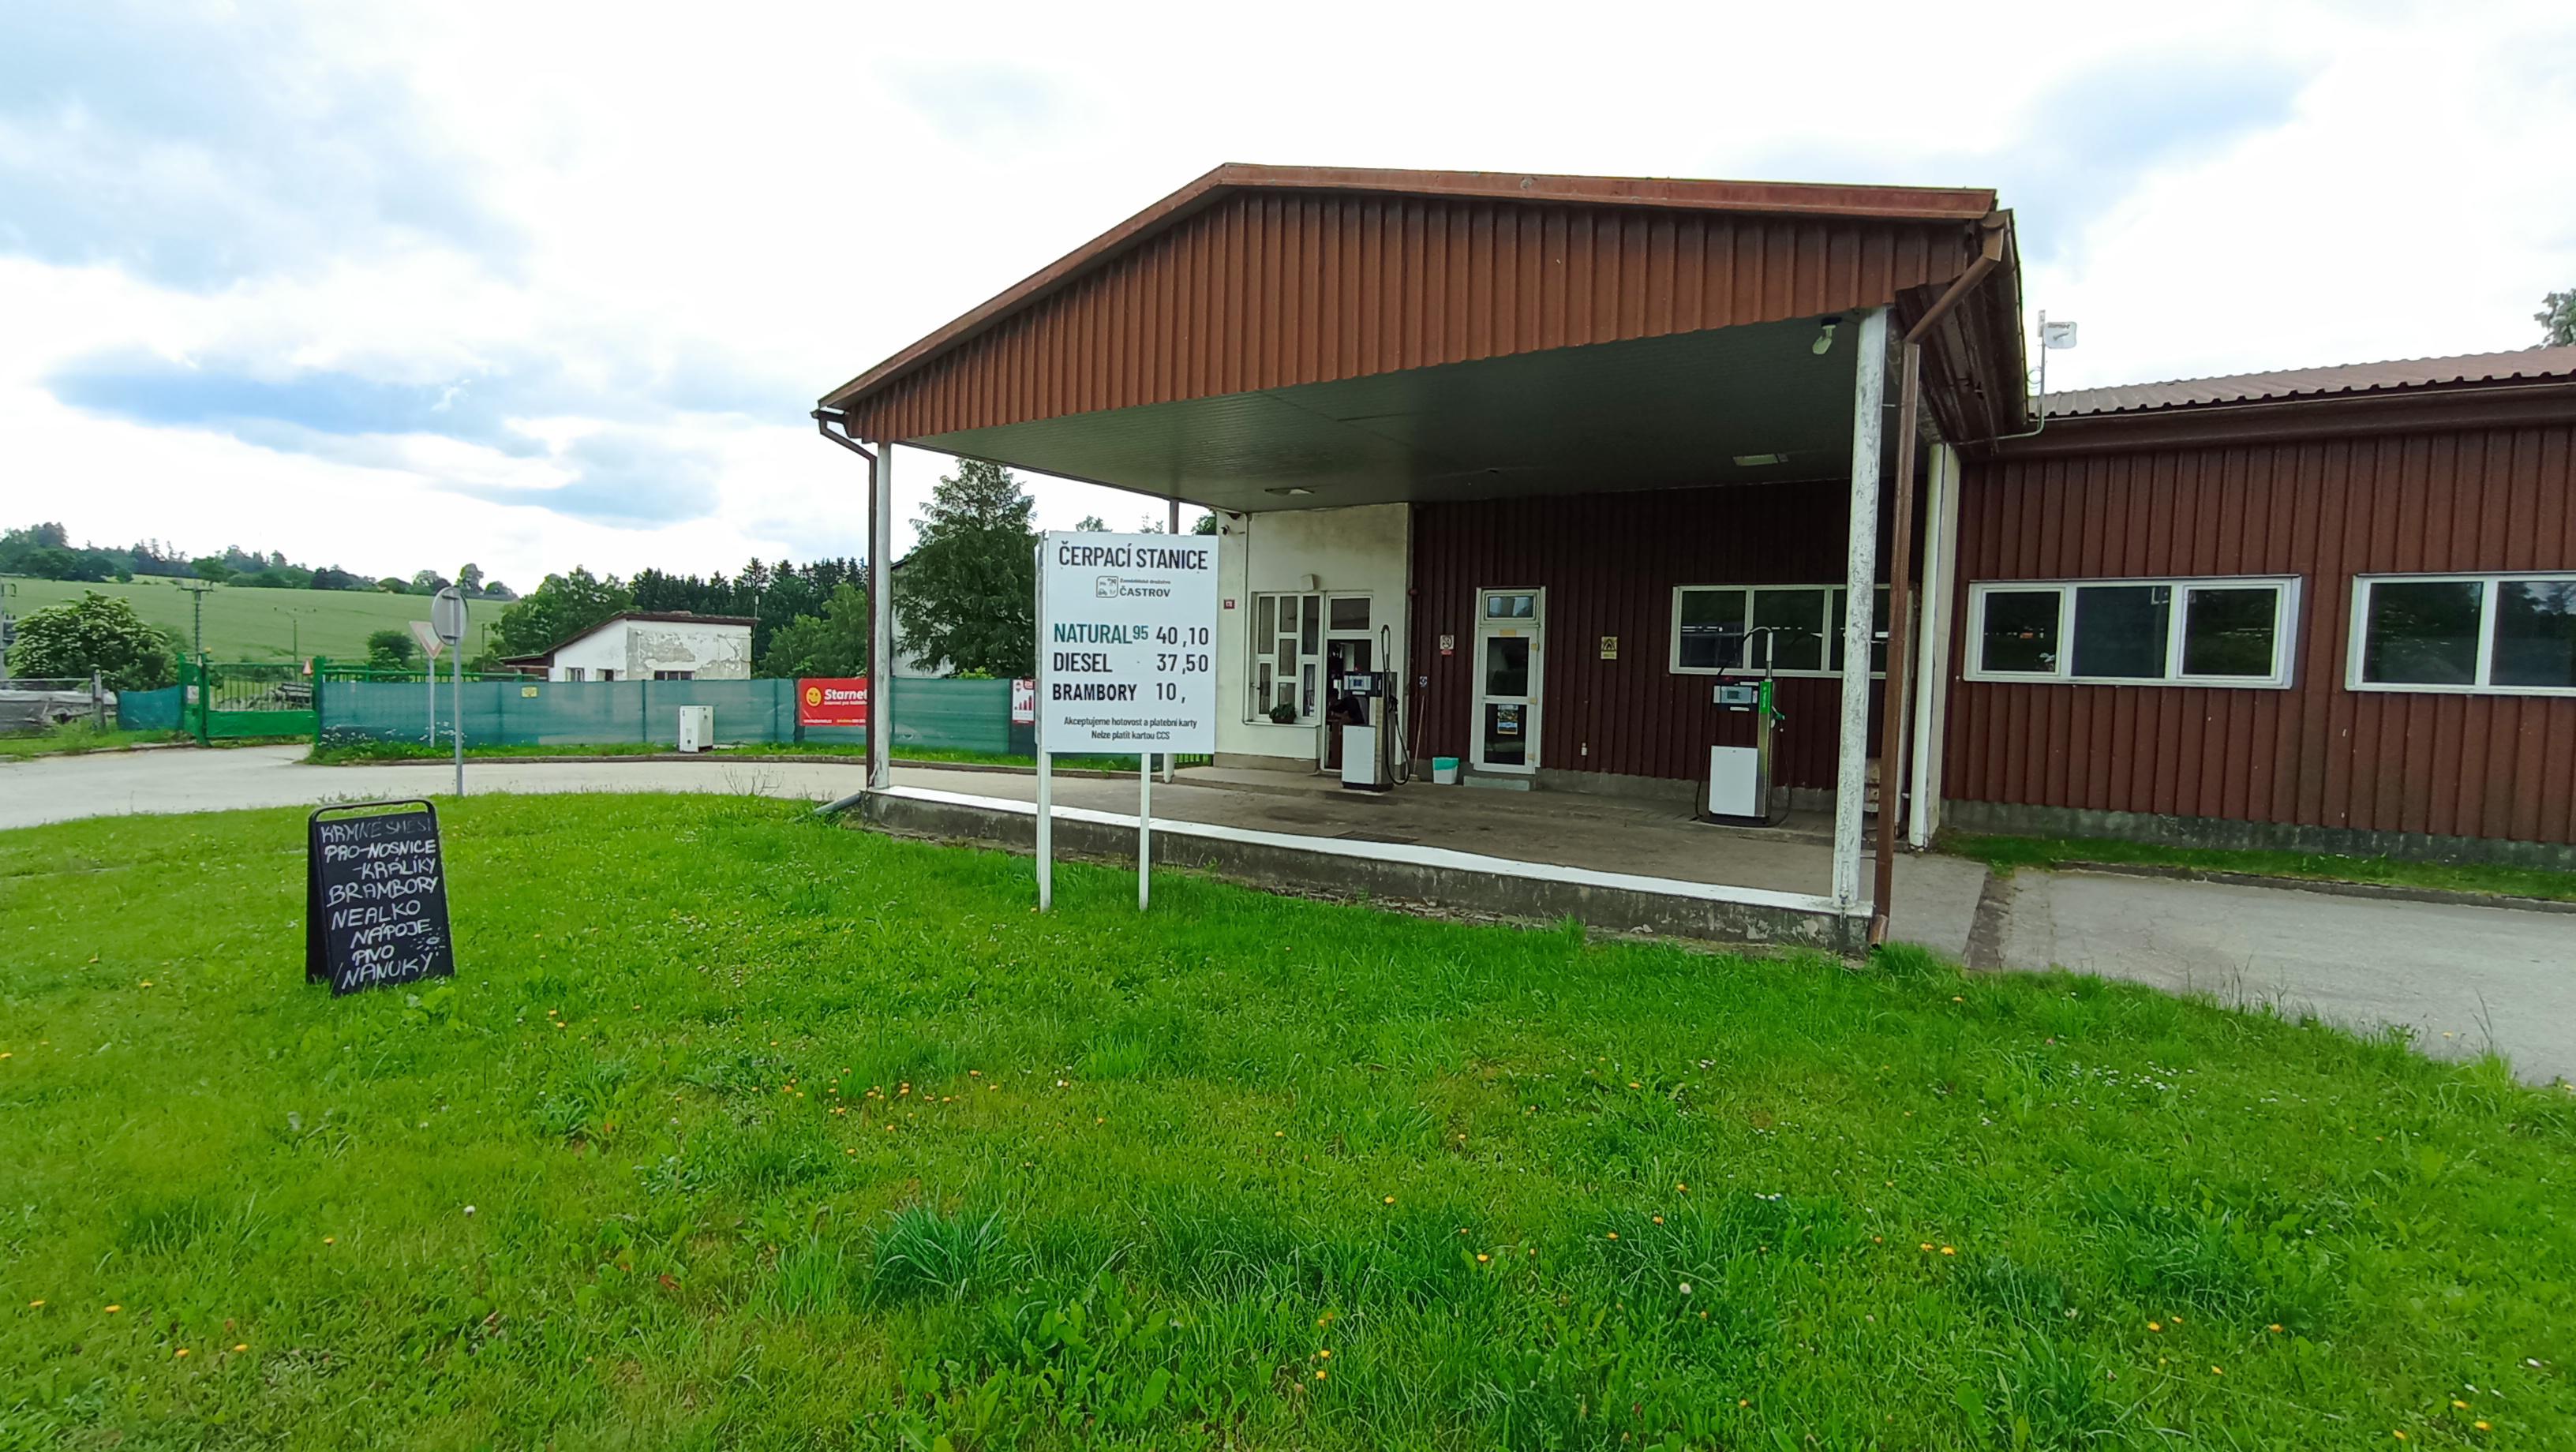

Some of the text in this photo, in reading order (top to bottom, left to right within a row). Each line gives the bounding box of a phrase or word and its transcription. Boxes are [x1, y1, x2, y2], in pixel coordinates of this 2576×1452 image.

[1059, 541, 1208, 570] ČERPACÍ STANICE
[1119, 585, 1171, 597] ČASTROV
[1054, 652, 1114, 672] DIESEL
[1052, 683, 1138, 702] BRAMBORY
[1064, 717, 1110, 728] Akceptujeme
[1111, 717, 1143, 727] hotovost
[1149, 717, 1178, 728] platební
[1178, 718, 1197, 729] karty
[1091, 730, 1111, 739] Nelze
[1132, 731, 1155, 740] kartou
[1156, 731, 1170, 740] CCS
[326, 876, 439, 908] BRAMBORY
[331, 900, 421, 930] NEALKO
[350, 919, 433, 949] NÁPOJE
[351, 945, 395, 966] PIVO
[341, 952, 433, 990] NANUKY
